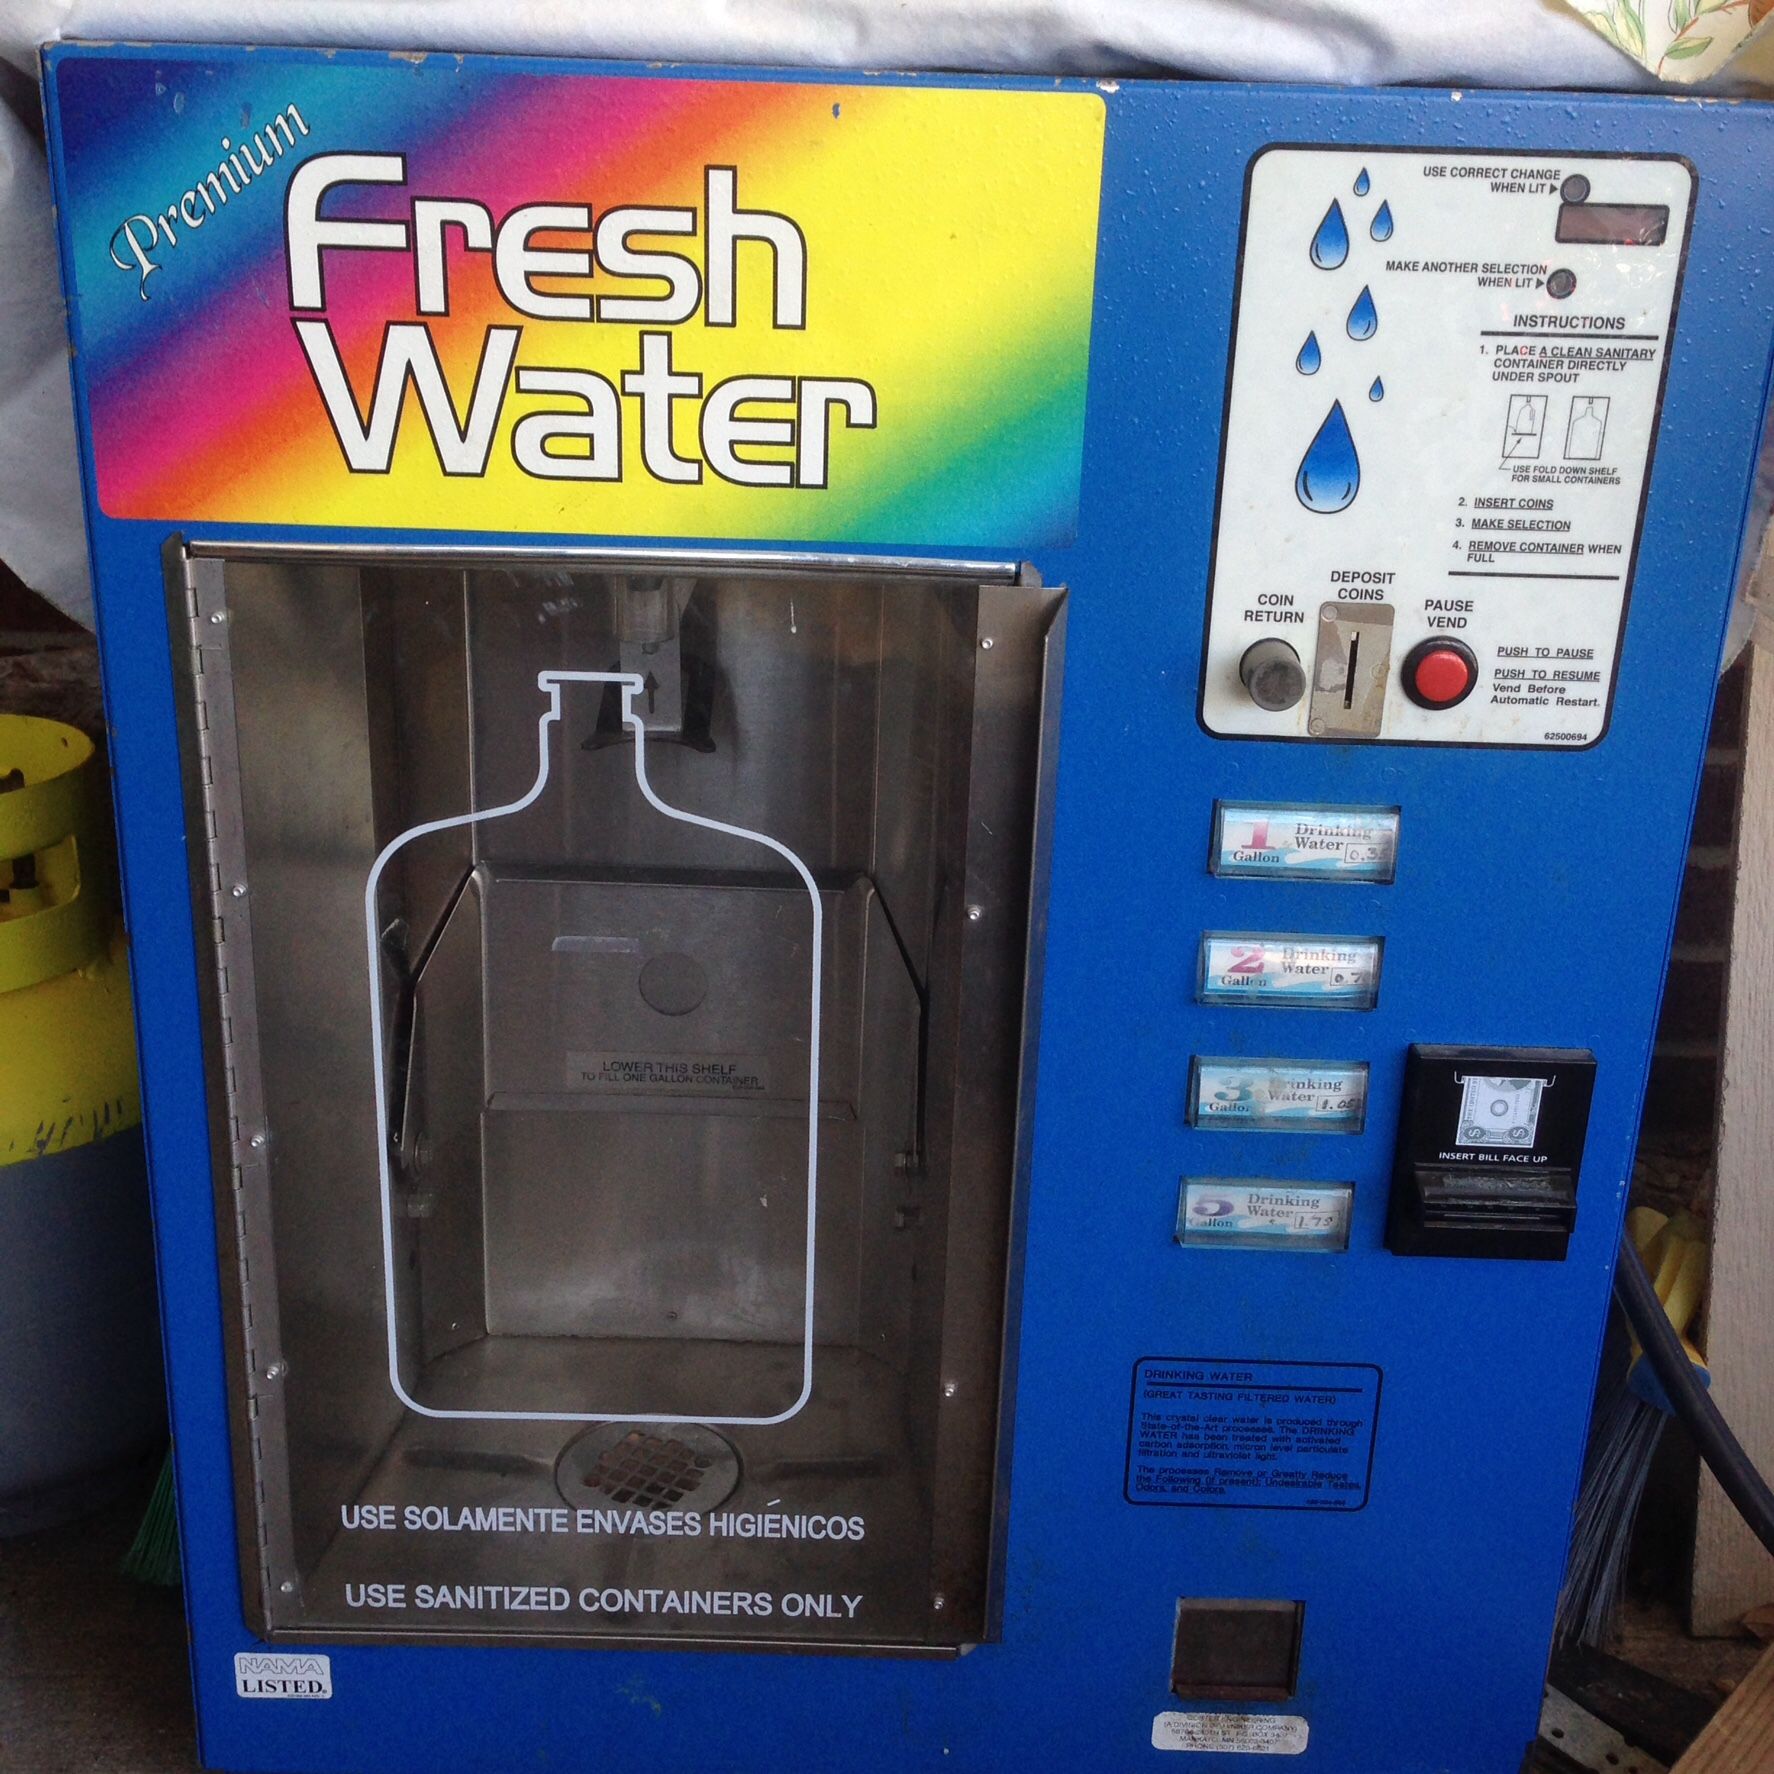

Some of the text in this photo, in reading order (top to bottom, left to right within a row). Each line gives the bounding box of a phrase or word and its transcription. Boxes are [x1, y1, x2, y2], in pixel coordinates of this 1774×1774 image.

[1423, 167, 1560, 180] USE CORRECT CHANGE
[1491, 182, 1546, 193] WHEN LIT
[110, 103, 310, 300] Premium
[283, 151, 807, 330] Fresh
[1386, 261, 1547, 274] MAKE ANOTHER SELECTION
[1478, 277, 1532, 288] WHEN LIT
[1513, 315, 1625, 330] INSTRUCTIONS
[1480, 345, 1656, 359] 1. PLACE A CLEAN SANITARY
[1494, 359, 1626, 371] CONTAINER DIRECTLY
[1493, 372, 1579, 383] UNDER SPOUT
[291, 318, 877, 490] Water
[1533, 466, 1556, 474] FOLD
[1564, 477, 1620, 485] CONTAINERS
[1458, 498, 1554, 509] 2. INSERT COINS
[1456, 519, 1571, 530] 3. MAKE SELECTION
[1452, 541, 1622, 554] 4. REMOVE CONTAINER WHEN
[1467, 553, 1494, 562] FULL
[1331, 571, 1396, 584] DEPOSIT
[1258, 594, 1294, 606] COIN
[1338, 588, 1384, 600] COINS
[1425, 600, 1474, 612] PAUSE
[1244, 610, 1304, 623] RETURN
[1427, 616, 1467, 628] VEND
[1497, 646, 1594, 658] PUSH TO PAUSE
[1495, 669, 1601, 680] PUSH TO RESUME
[1493, 684, 1566, 694] Vend Before
[1491, 695, 1600, 707] Automatic Restart.
[1544, 733, 1587, 741] 62500694
[1241, 821, 1275, 849] 1
[1295, 823, 1372, 840] Drinking
[1295, 836, 1343, 850] Water
[1233, 851, 1279, 863] Gallon
[1228, 944, 1265, 974] 2
[1282, 947, 1358, 963] Drinking
[1282, 962, 1329, 975] Water
[603, 1061, 736, 1074] LOWER THIS SHELF
[582, 1072, 758, 1085] TO FILL ONE GALLON CONTAINER
[1214, 1077, 1253, 1101] 3
[1268, 1090, 1315, 1101] Water
[1439, 1152, 1547, 1163] INSERT BILL FACE UP
[1248, 1194, 1320, 1209] Drinking
[1248, 1205, 1293, 1218] Water
[1145, 1370, 1253, 1381] DRINKING WATER
[1144, 1389, 1336, 1405] (GREAT TASTING FILTERED WATER)
[341, 1499, 865, 1540] USE SOLAMENTE ENVASES HIGIÉNICOS
[346, 1584, 863, 1618] USE SANITIZED CONTAINERS ONLY
[239, 1657, 324, 1675] NAMA
